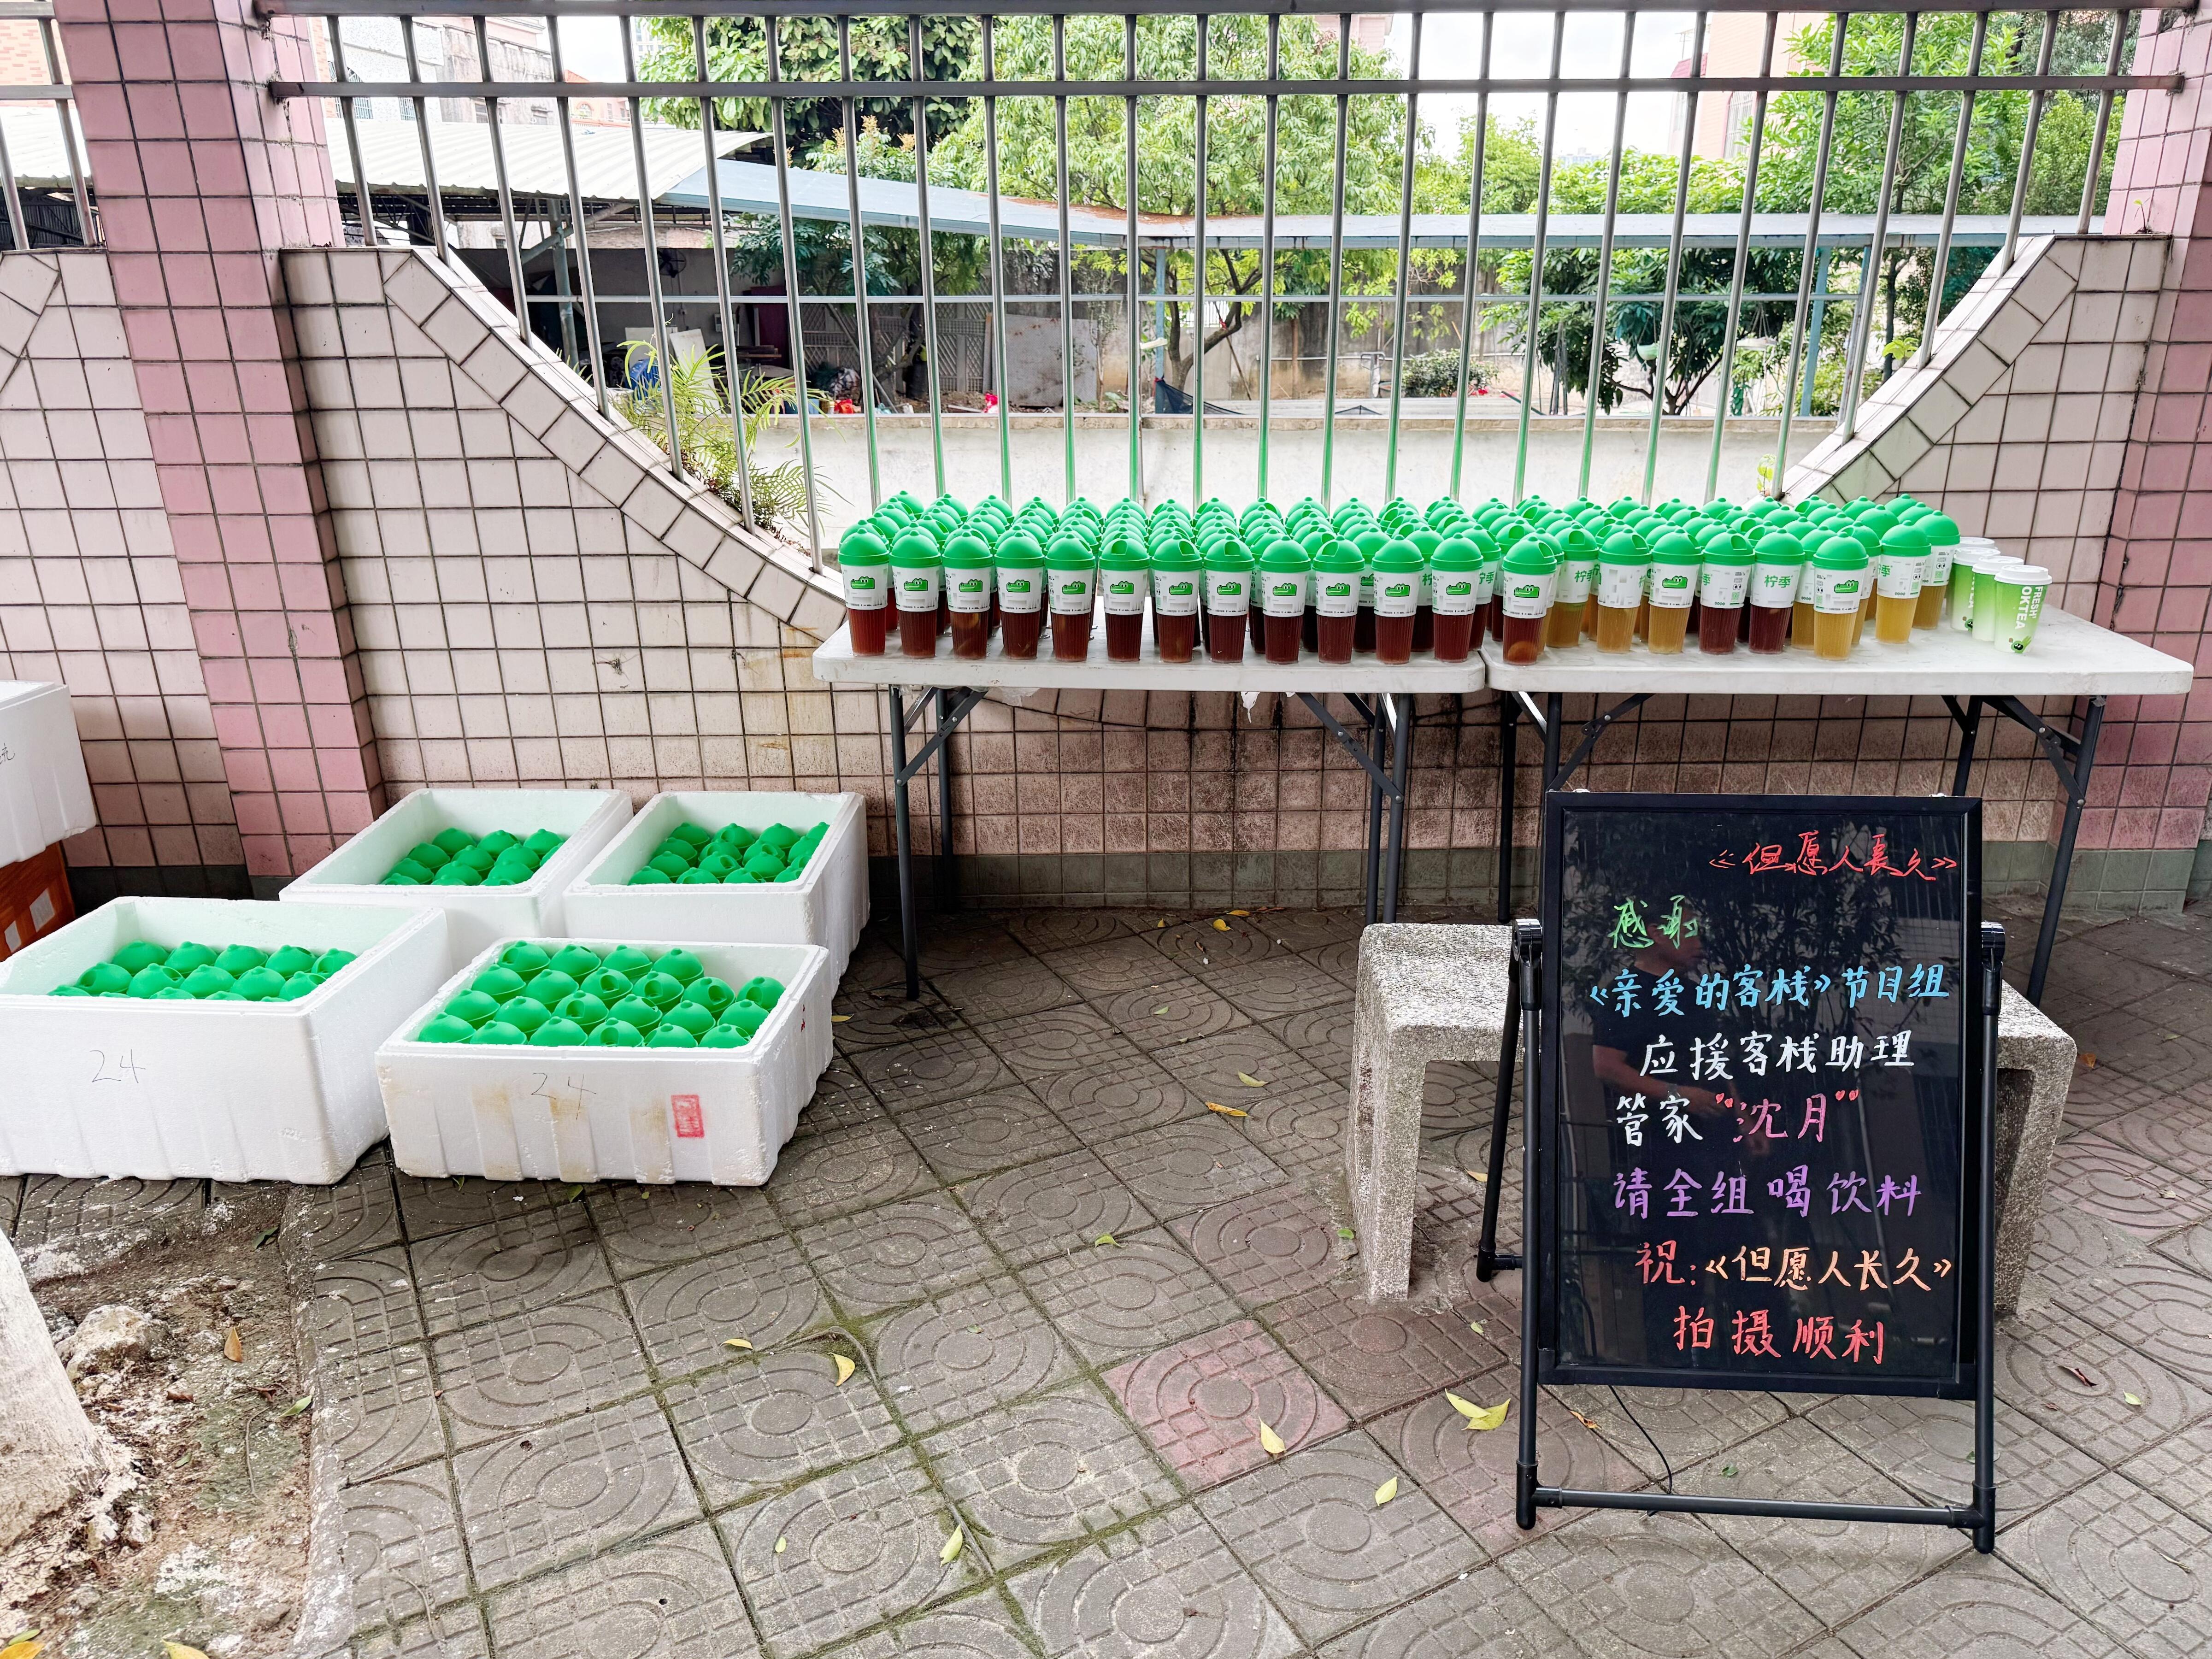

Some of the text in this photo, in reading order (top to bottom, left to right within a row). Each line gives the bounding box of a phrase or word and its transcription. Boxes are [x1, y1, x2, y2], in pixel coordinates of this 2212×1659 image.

[1764, 575, 1791, 588] 柠季
[2015, 586, 2032, 629] OKTEA
[1589, 963, 1949, 1018] 《亲爱的客栈》节目组
[89, 1049, 146, 1084] 24
[1639, 1029, 1915, 1081] 应援客栈助理
[531, 1072, 597, 1120] 24
[1614, 1165, 1922, 1219] 请全组喝饮料
[1673, 1305, 1884, 1364] 拍摄顺利
